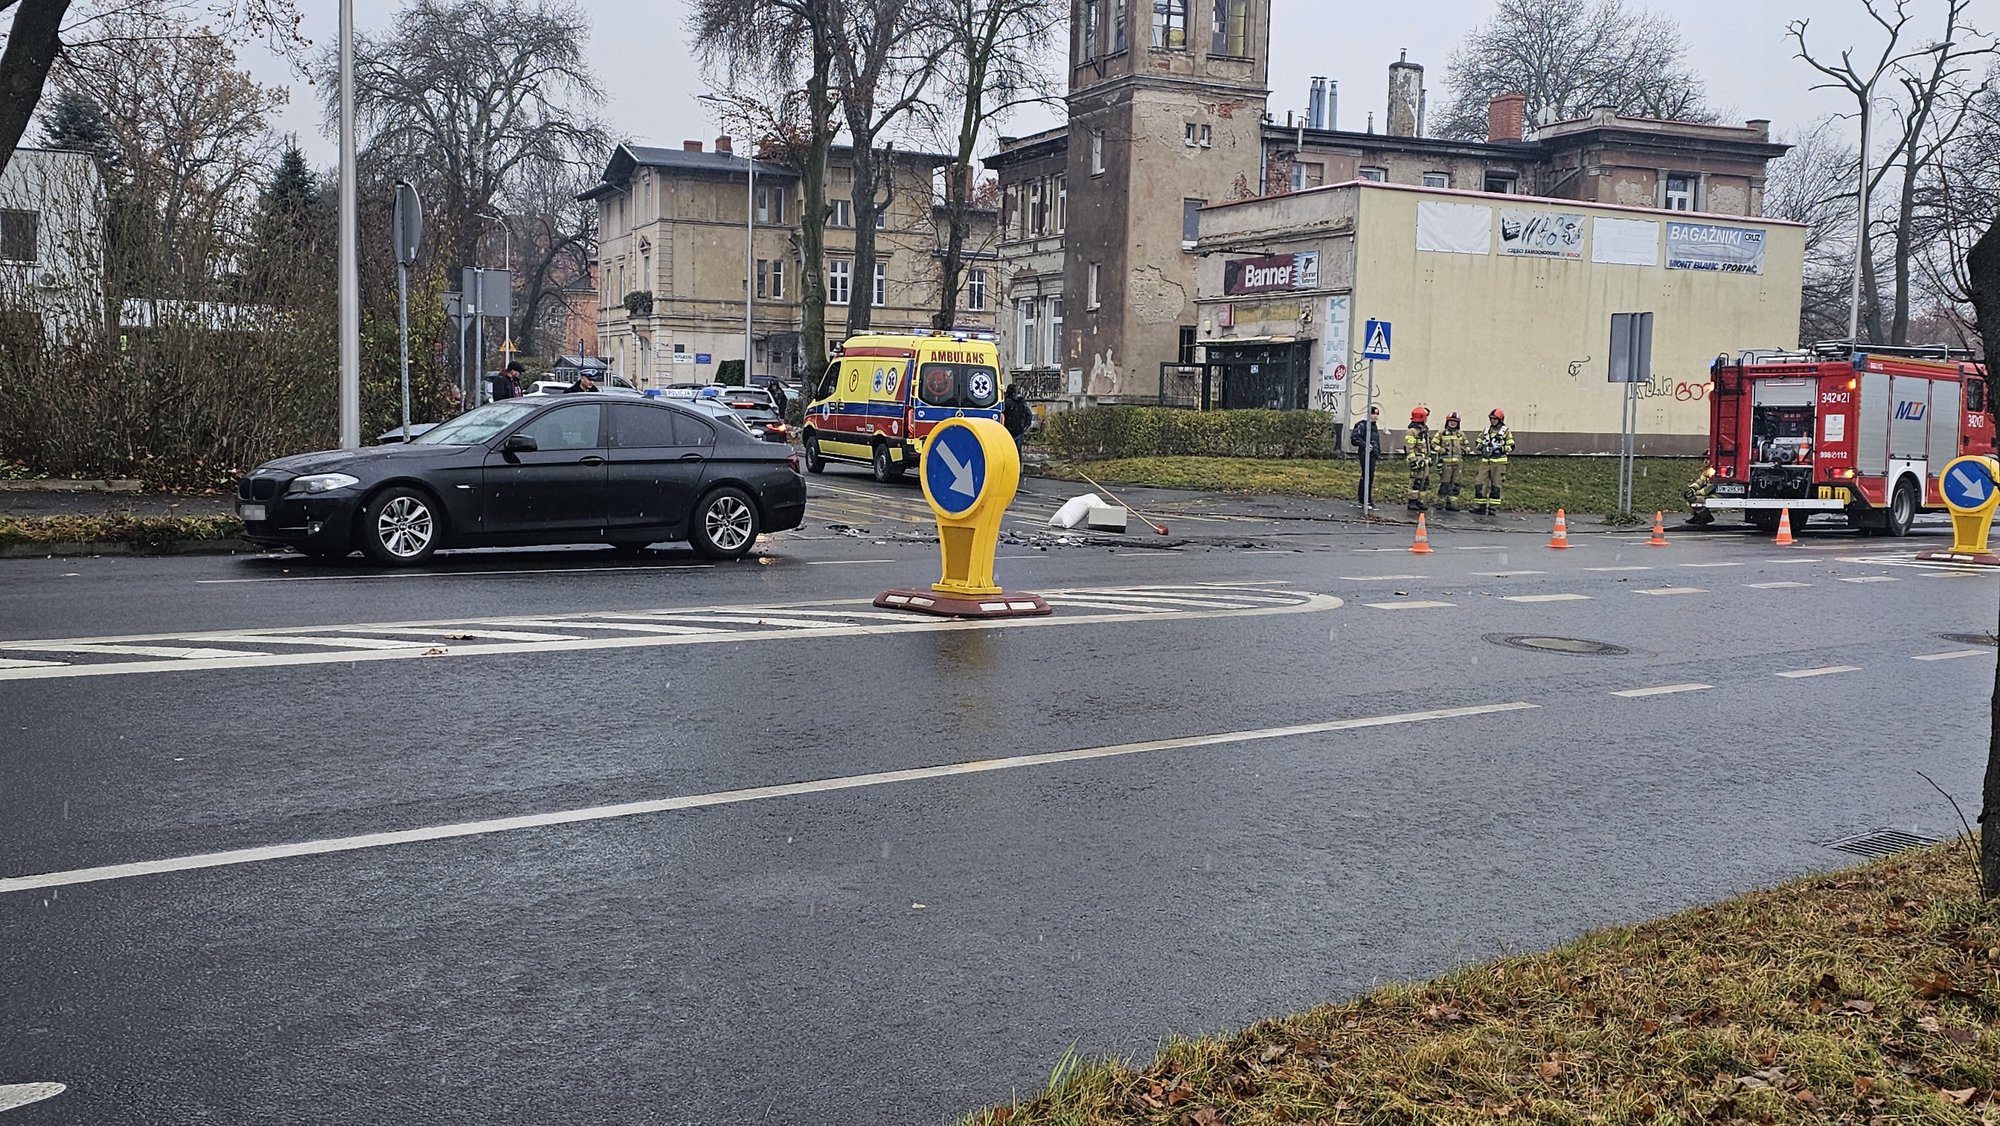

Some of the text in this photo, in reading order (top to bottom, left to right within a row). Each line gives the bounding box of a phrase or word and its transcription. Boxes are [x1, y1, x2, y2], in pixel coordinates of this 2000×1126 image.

[1670, 225, 1742, 245] BAGAŻNIKI
[1245, 264, 1293, 288] Banner
[1325, 298, 1347, 365] KLIMA
[930, 351, 985, 364] AMBULANS
